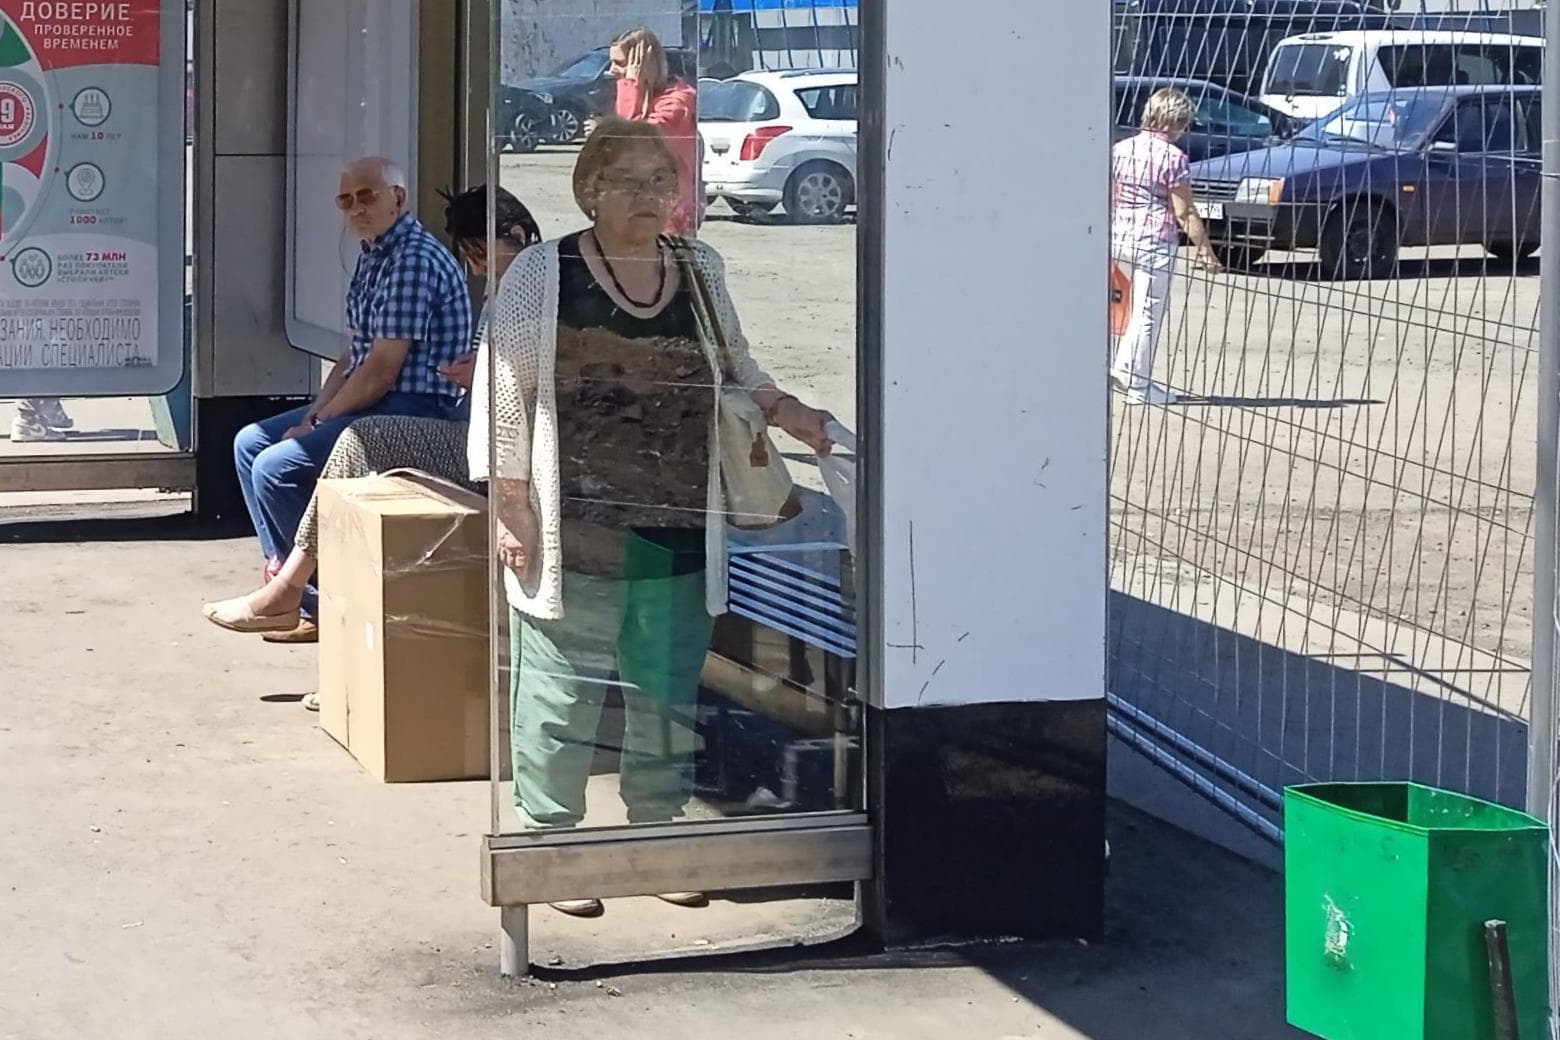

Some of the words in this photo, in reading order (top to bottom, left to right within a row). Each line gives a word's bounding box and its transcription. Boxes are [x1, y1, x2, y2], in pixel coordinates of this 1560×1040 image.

[34, 24, 134, 36] ПРОВЕРЕННОЕ
[43, 37, 119, 50] ВРЕМЕНЕМ
[91, 131, 104, 140] 10
[70, 215, 97, 224] 1000
[86, 252, 99, 261] 73
[102, 252, 127, 261] МЛН
[49, 317, 141, 341] НЕОБХОДИМО
[41, 343, 140, 367] СПЕЦИАЛИСТА
